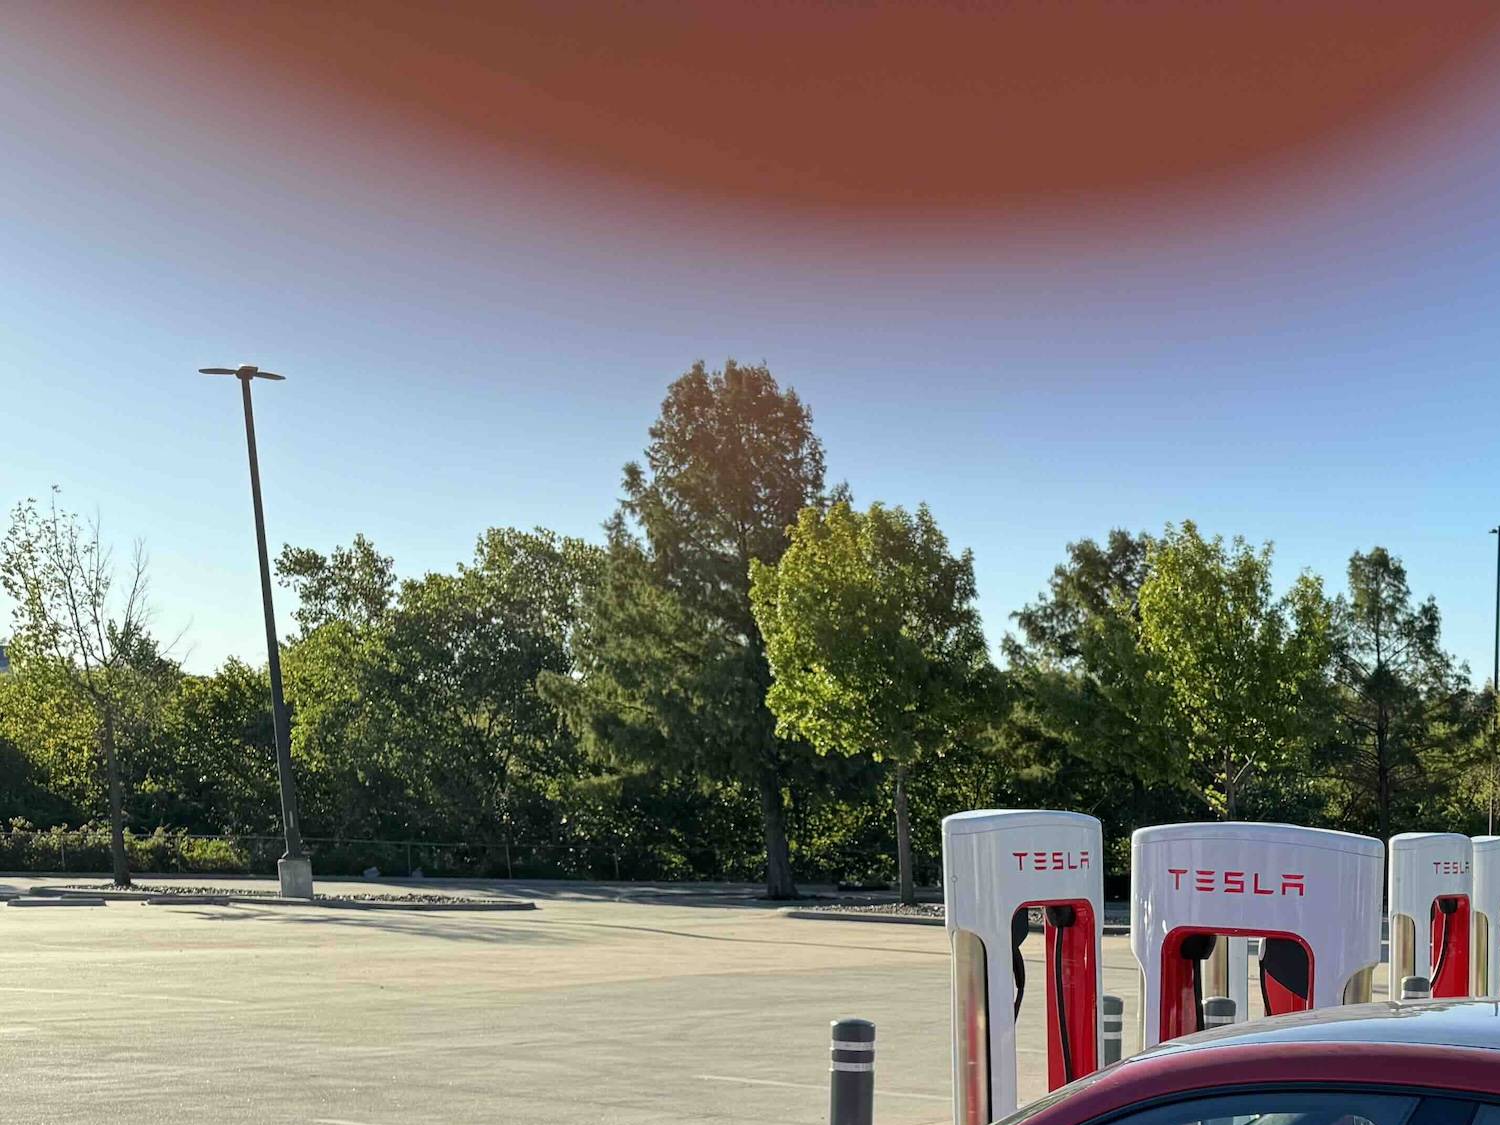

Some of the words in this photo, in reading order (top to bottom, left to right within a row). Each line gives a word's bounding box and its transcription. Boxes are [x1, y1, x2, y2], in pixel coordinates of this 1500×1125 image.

[1012, 851, 1090, 871] TESLA
[1433, 861, 1470, 875] TESLA
[1168, 868, 1305, 897] TESLA
